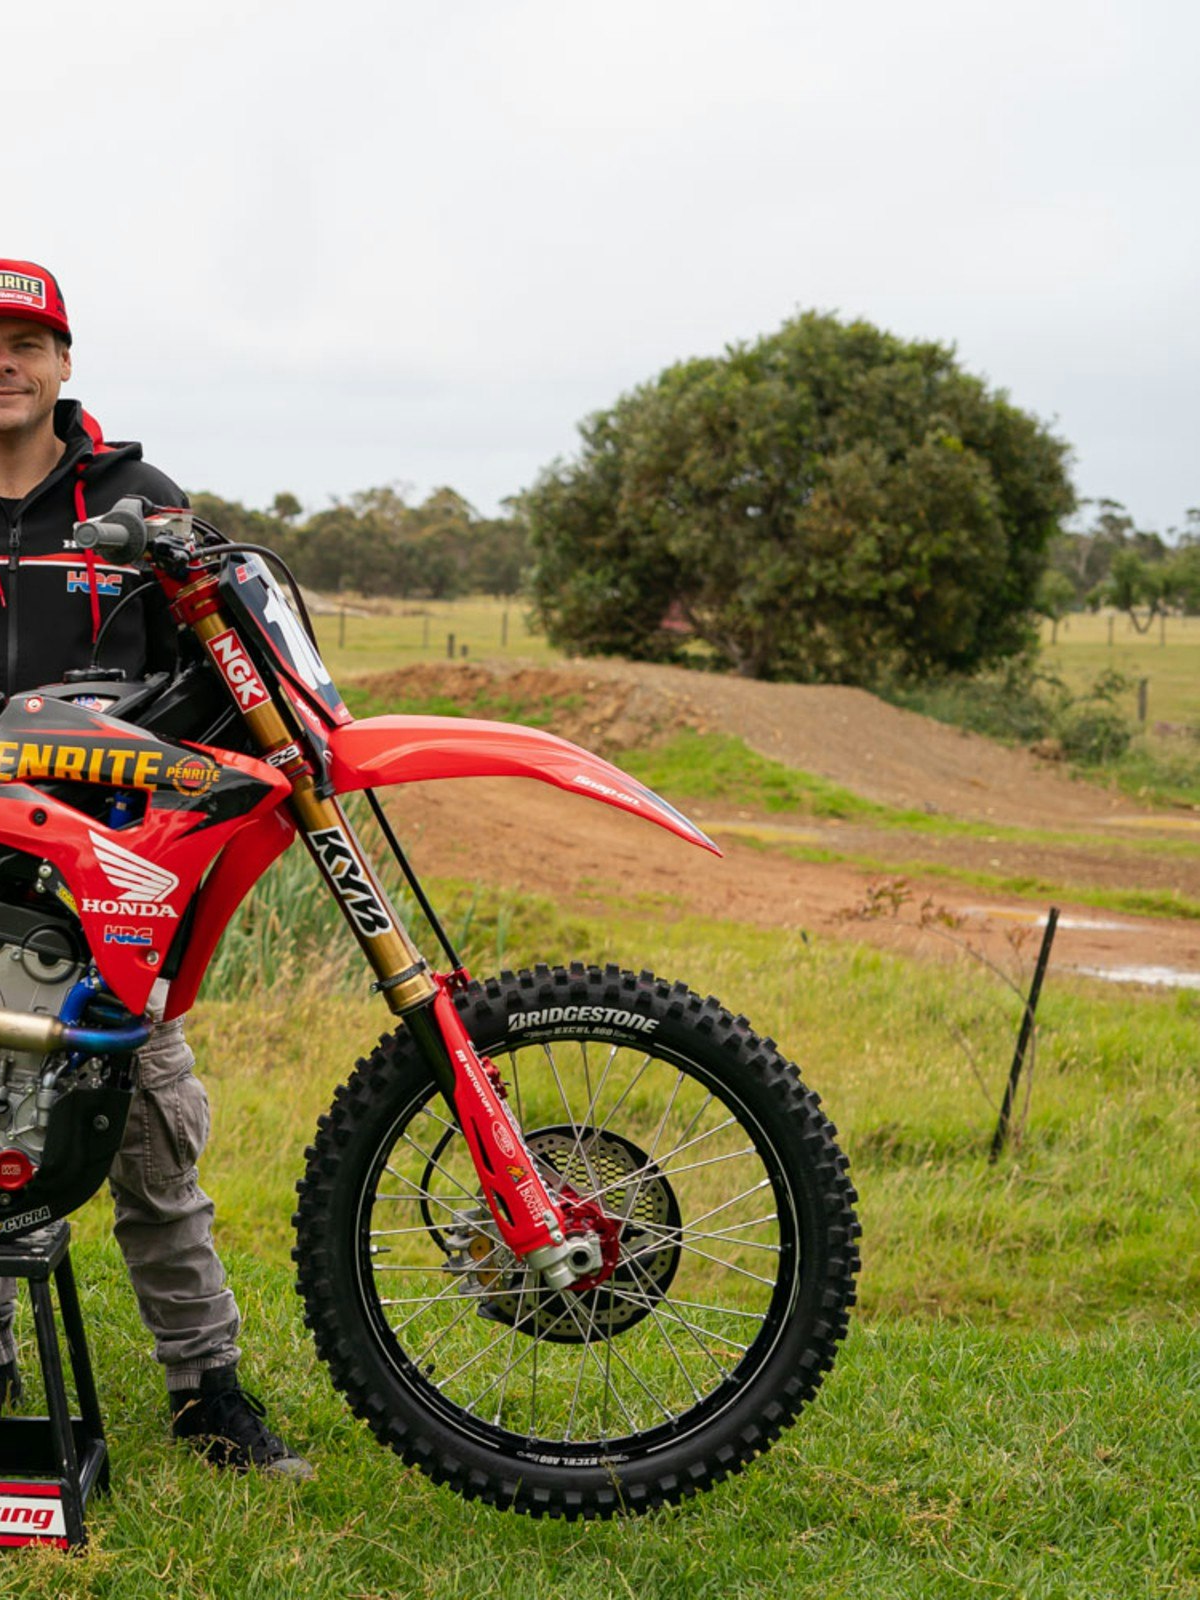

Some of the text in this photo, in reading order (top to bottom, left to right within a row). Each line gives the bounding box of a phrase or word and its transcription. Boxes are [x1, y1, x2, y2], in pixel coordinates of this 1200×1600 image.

[212, 634, 265, 706] NGK
[166, 766, 221, 782] PENRITE
[307, 823, 393, 938] KYB
[81, 898, 179, 918] HONDA
[104, 924, 153, 946] HRC
[507, 1005, 661, 1034] BRIDGESTONE
[553, 1026, 591, 1036] EXCEL
[3, 1206, 52, 1233] CYCRA
